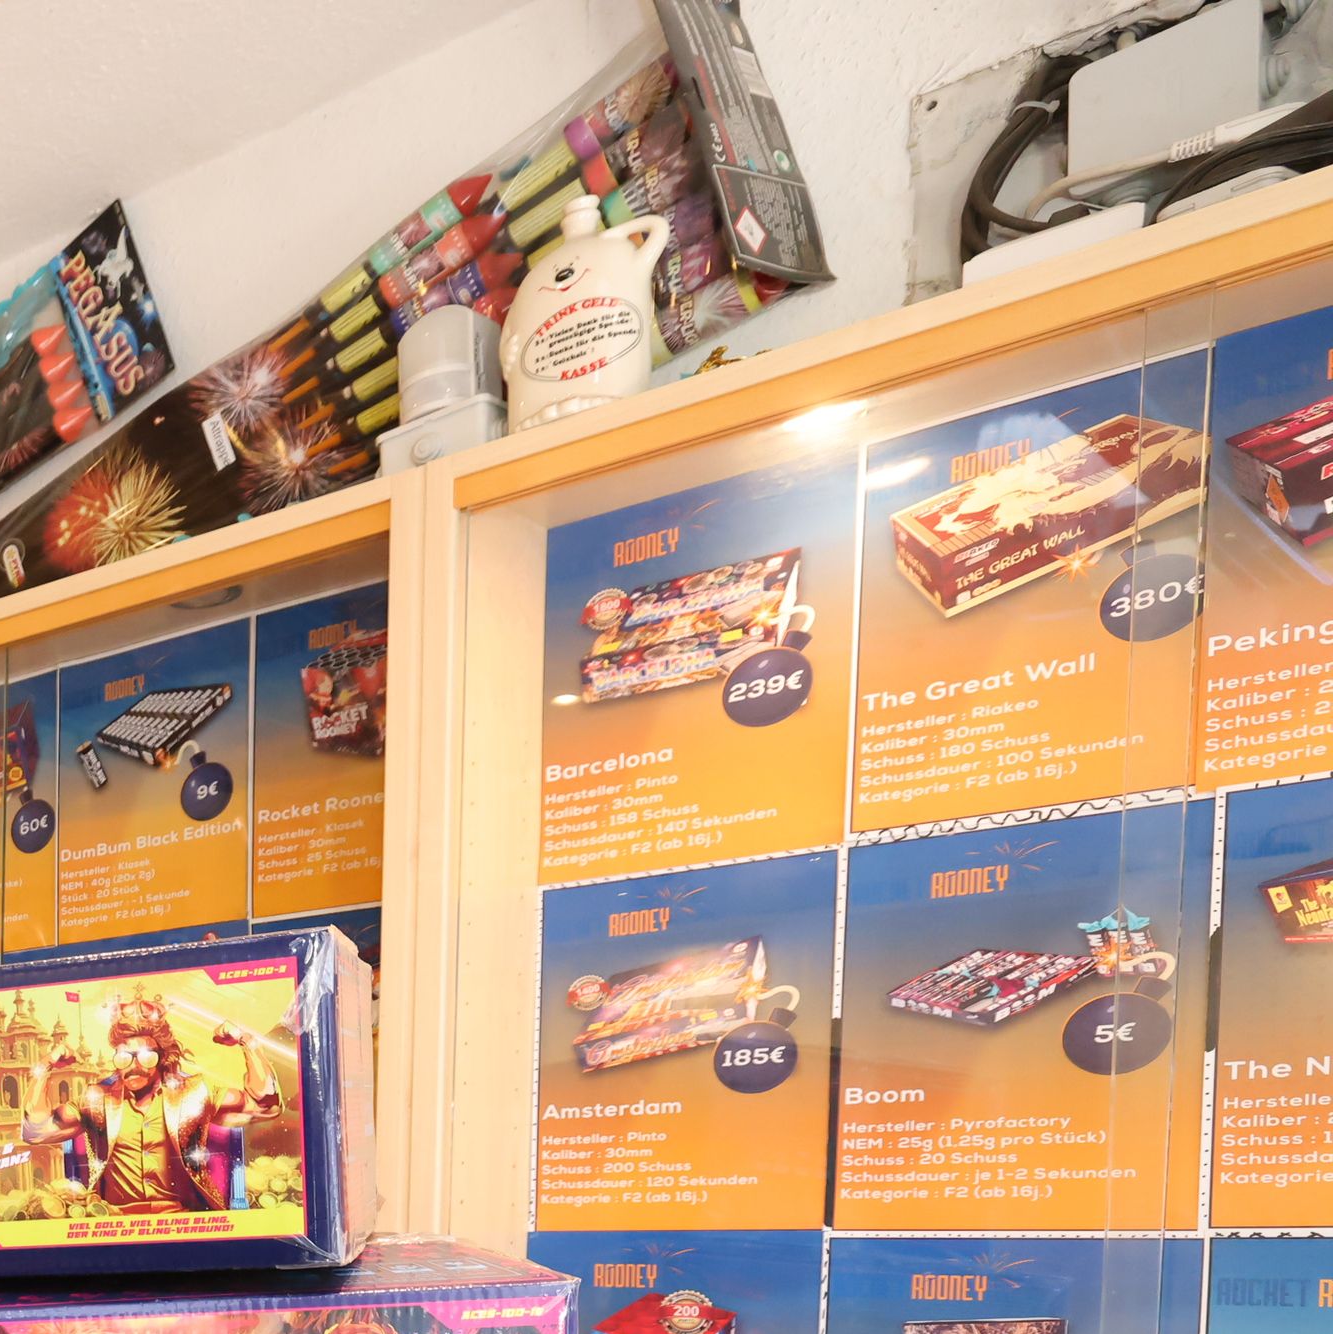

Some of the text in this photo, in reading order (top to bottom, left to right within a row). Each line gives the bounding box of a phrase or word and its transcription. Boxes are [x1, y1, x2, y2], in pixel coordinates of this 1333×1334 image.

[60, 249, 146, 396] PEGASUS
[536, 303, 578, 337] TRINK
[559, 357, 608, 380] KASSE
[1109, 573, 1205, 619] 380€
[727, 669, 804, 704] 239€
[925, 669, 1014, 701] Great
[1205, 686, 1297, 713] Kaliber
[544, 746, 674, 784] Barcelona
[859, 731, 1145, 789] Schussdauer Sekunden
[1203, 744, 1327, 774] Kategorie
[258, 801, 320, 825] Rocket
[60, 818, 245, 863] DumBum Black Edition
[258, 825, 317, 845] Hersteller
[544, 828, 649, 854] Schussdauer
[721, 1044, 787, 1068] 185€
[1223, 1059, 1293, 1082] The
[844, 1085, 925, 1105] Boom
[542, 1099, 682, 1120] Amsterdam
[842, 1113, 1072, 1135] Hersteller Pyrofactory
[541, 1177, 637, 1191] Schussdauer
[841, 1168, 959, 1183] Schussdauer
